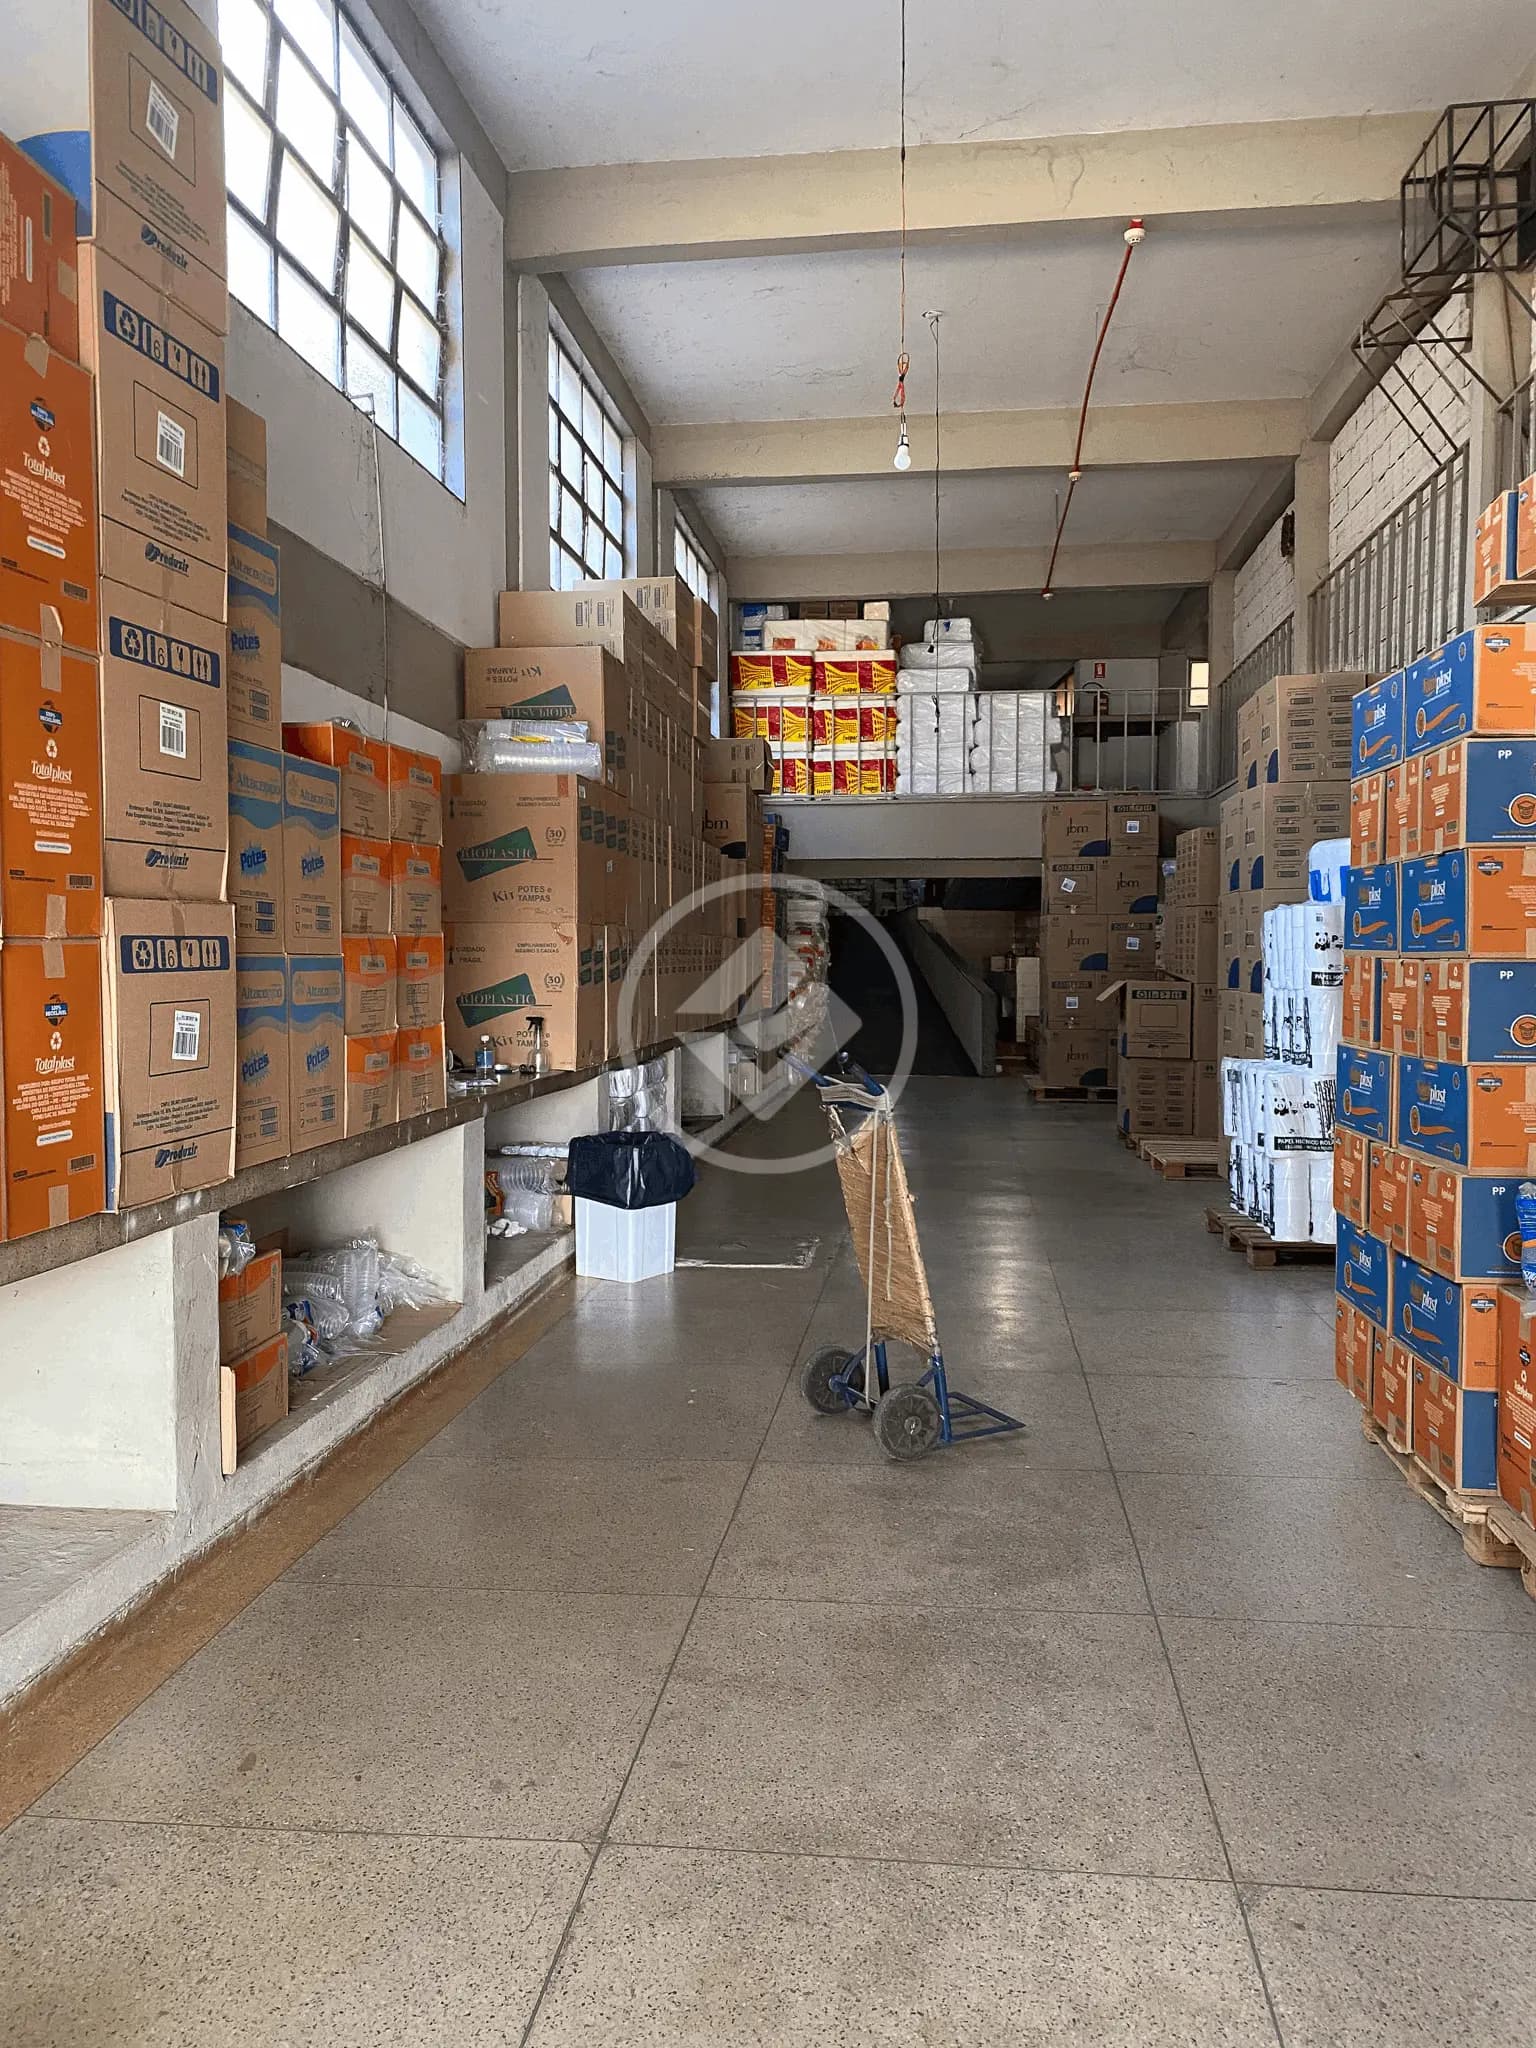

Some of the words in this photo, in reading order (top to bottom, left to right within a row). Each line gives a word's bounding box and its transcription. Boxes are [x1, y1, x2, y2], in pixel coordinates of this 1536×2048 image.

[231, 633, 260, 650] Potes
[1497, 750, 1512, 759] PP
[31, 760, 72, 782] Totalplast
[701, 810, 729, 832] jbm
[1066, 816, 1089, 836] jbm
[239, 849, 267, 871] Potes
[301, 855, 325, 876] Potes
[517, 885, 545, 893] POTES
[1116, 872, 1140, 890] jbm
[517, 894, 551, 902] TAMPAS
[1067, 929, 1090, 947] jbm
[1500, 970, 1514, 980] PP
[35, 1055, 75, 1075] Totalplast
[241, 1053, 269, 1081] Potes
[306, 1046, 330, 1072] Potes
[164, 1142, 198, 1161] Produzir
[1492, 1187, 1506, 1196] PP
